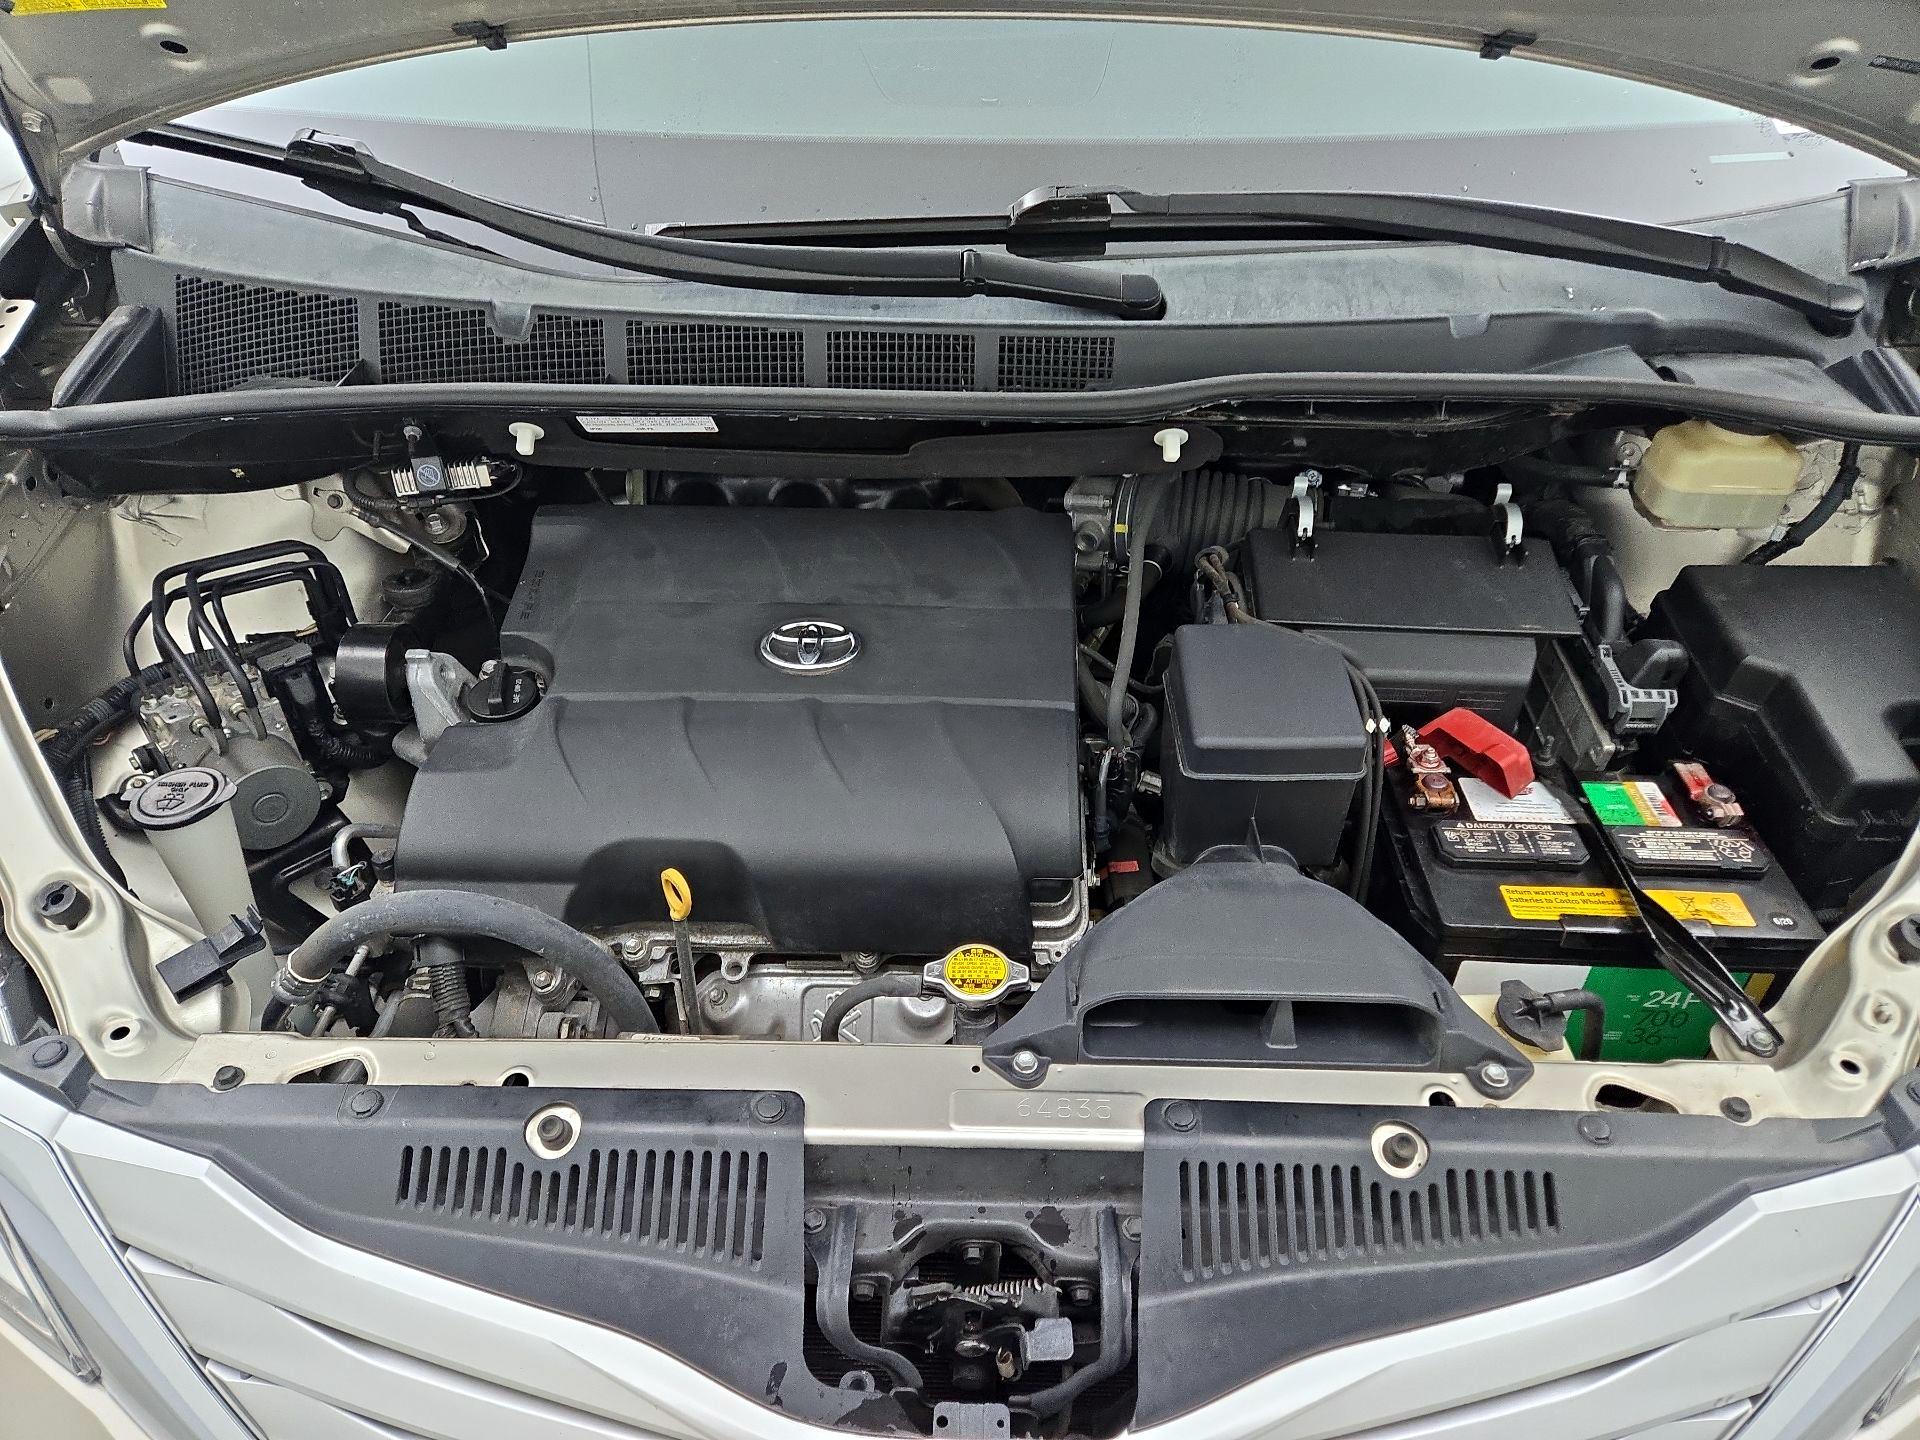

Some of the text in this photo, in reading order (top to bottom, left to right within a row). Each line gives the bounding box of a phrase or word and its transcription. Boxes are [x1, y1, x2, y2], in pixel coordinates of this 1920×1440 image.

[1465, 822, 1506, 830] DANGER
[1516, 823, 1552, 831] POISON
[1505, 888, 1532, 896] Return
[1534, 889, 1569, 898] warranty
[1587, 890, 1606, 898] used
[1510, 896, 1544, 904] batteries
[1555, 897, 1580, 905] Costco
[1772, 917, 1794, 926] 6/20
[1016, 1097, 1112, 1120] 64835
